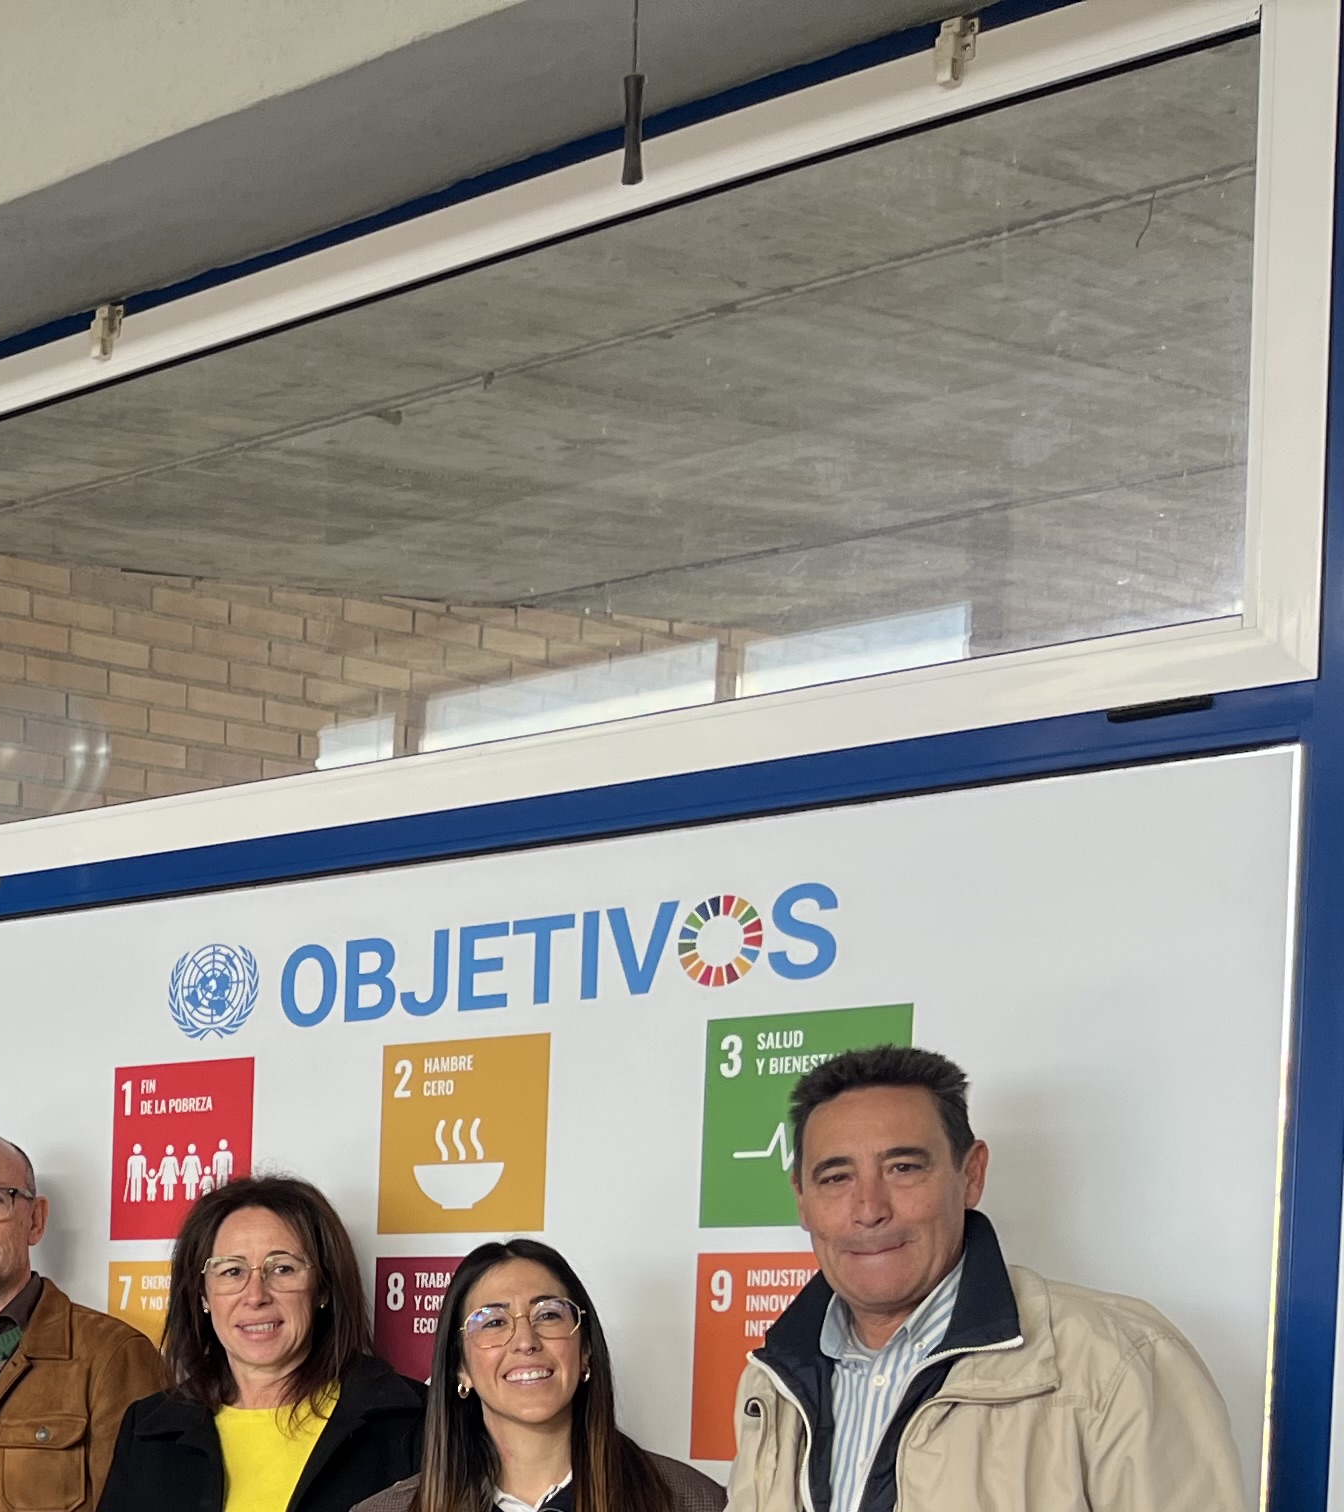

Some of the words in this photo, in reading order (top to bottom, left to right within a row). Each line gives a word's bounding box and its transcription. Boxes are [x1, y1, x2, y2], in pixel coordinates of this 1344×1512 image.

[280, 882, 839, 1027] OBJETIVOS
[756, 1030, 804, 1051] SALUD
[424, 1055, 474, 1074] HAMBRE
[719, 1034, 743, 1079] 3
[755, 1057, 765, 1076] Y
[140, 1079, 157, 1095] FIN
[393, 1059, 413, 1099] 2
[423, 1079, 454, 1097] CERO
[121, 1080, 133, 1117] 1
[140, 1100, 153, 1116] DE
[155, 1099, 167, 1115] LA
[169, 1096, 213, 1114] POBREZA
[414, 1272, 455, 1289] TRABA
[747, 1269, 819, 1288] INDUSTRI
[119, 1276, 132, 1311] 7
[386, 1272, 405, 1311] 8
[710, 1269, 733, 1313] 9
[140, 1296, 148, 1311] Y
[149, 1296, 163, 1311] NO
[414, 1295, 422, 1311] Y
